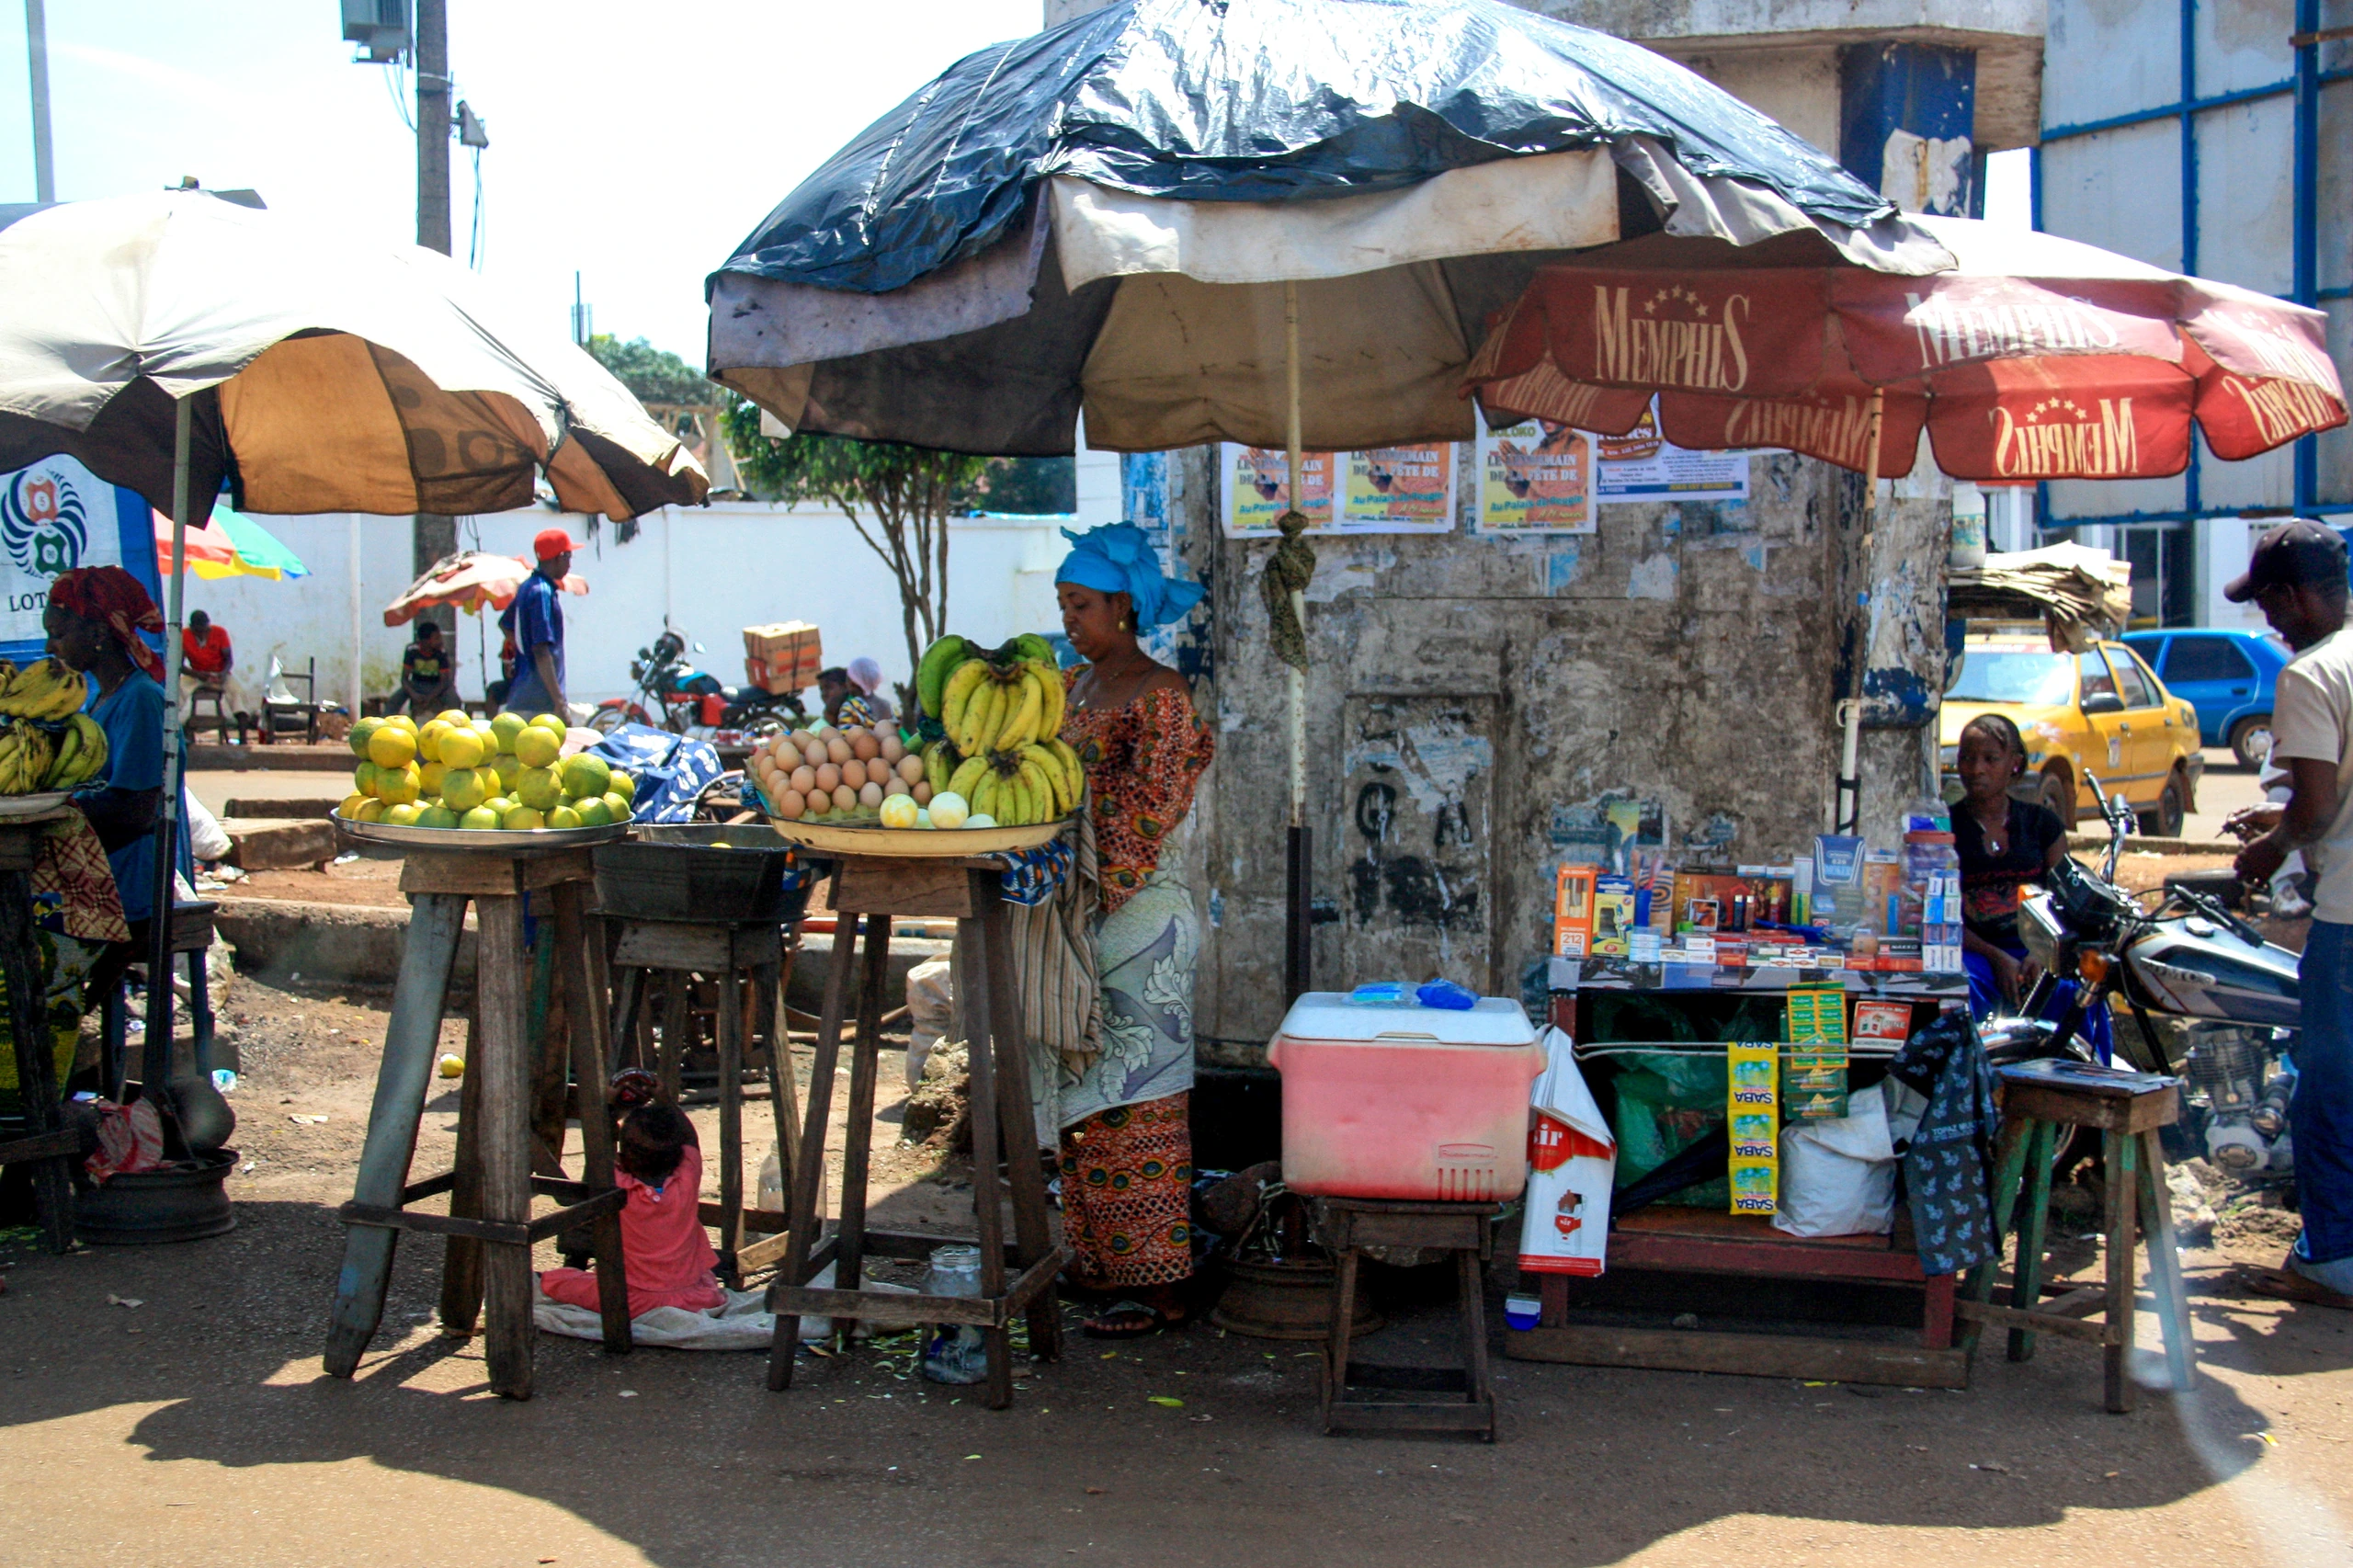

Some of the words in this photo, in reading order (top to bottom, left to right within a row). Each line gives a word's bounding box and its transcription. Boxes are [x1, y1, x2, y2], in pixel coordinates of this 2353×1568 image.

[1595, 286, 1749, 392] MEMPHIS
[1563, 934, 1583, 945] 212
[1734, 1092, 1773, 1104] SABA
[1734, 1145, 1774, 1158] SABA
[1735, 1199, 1774, 1210] SABA
